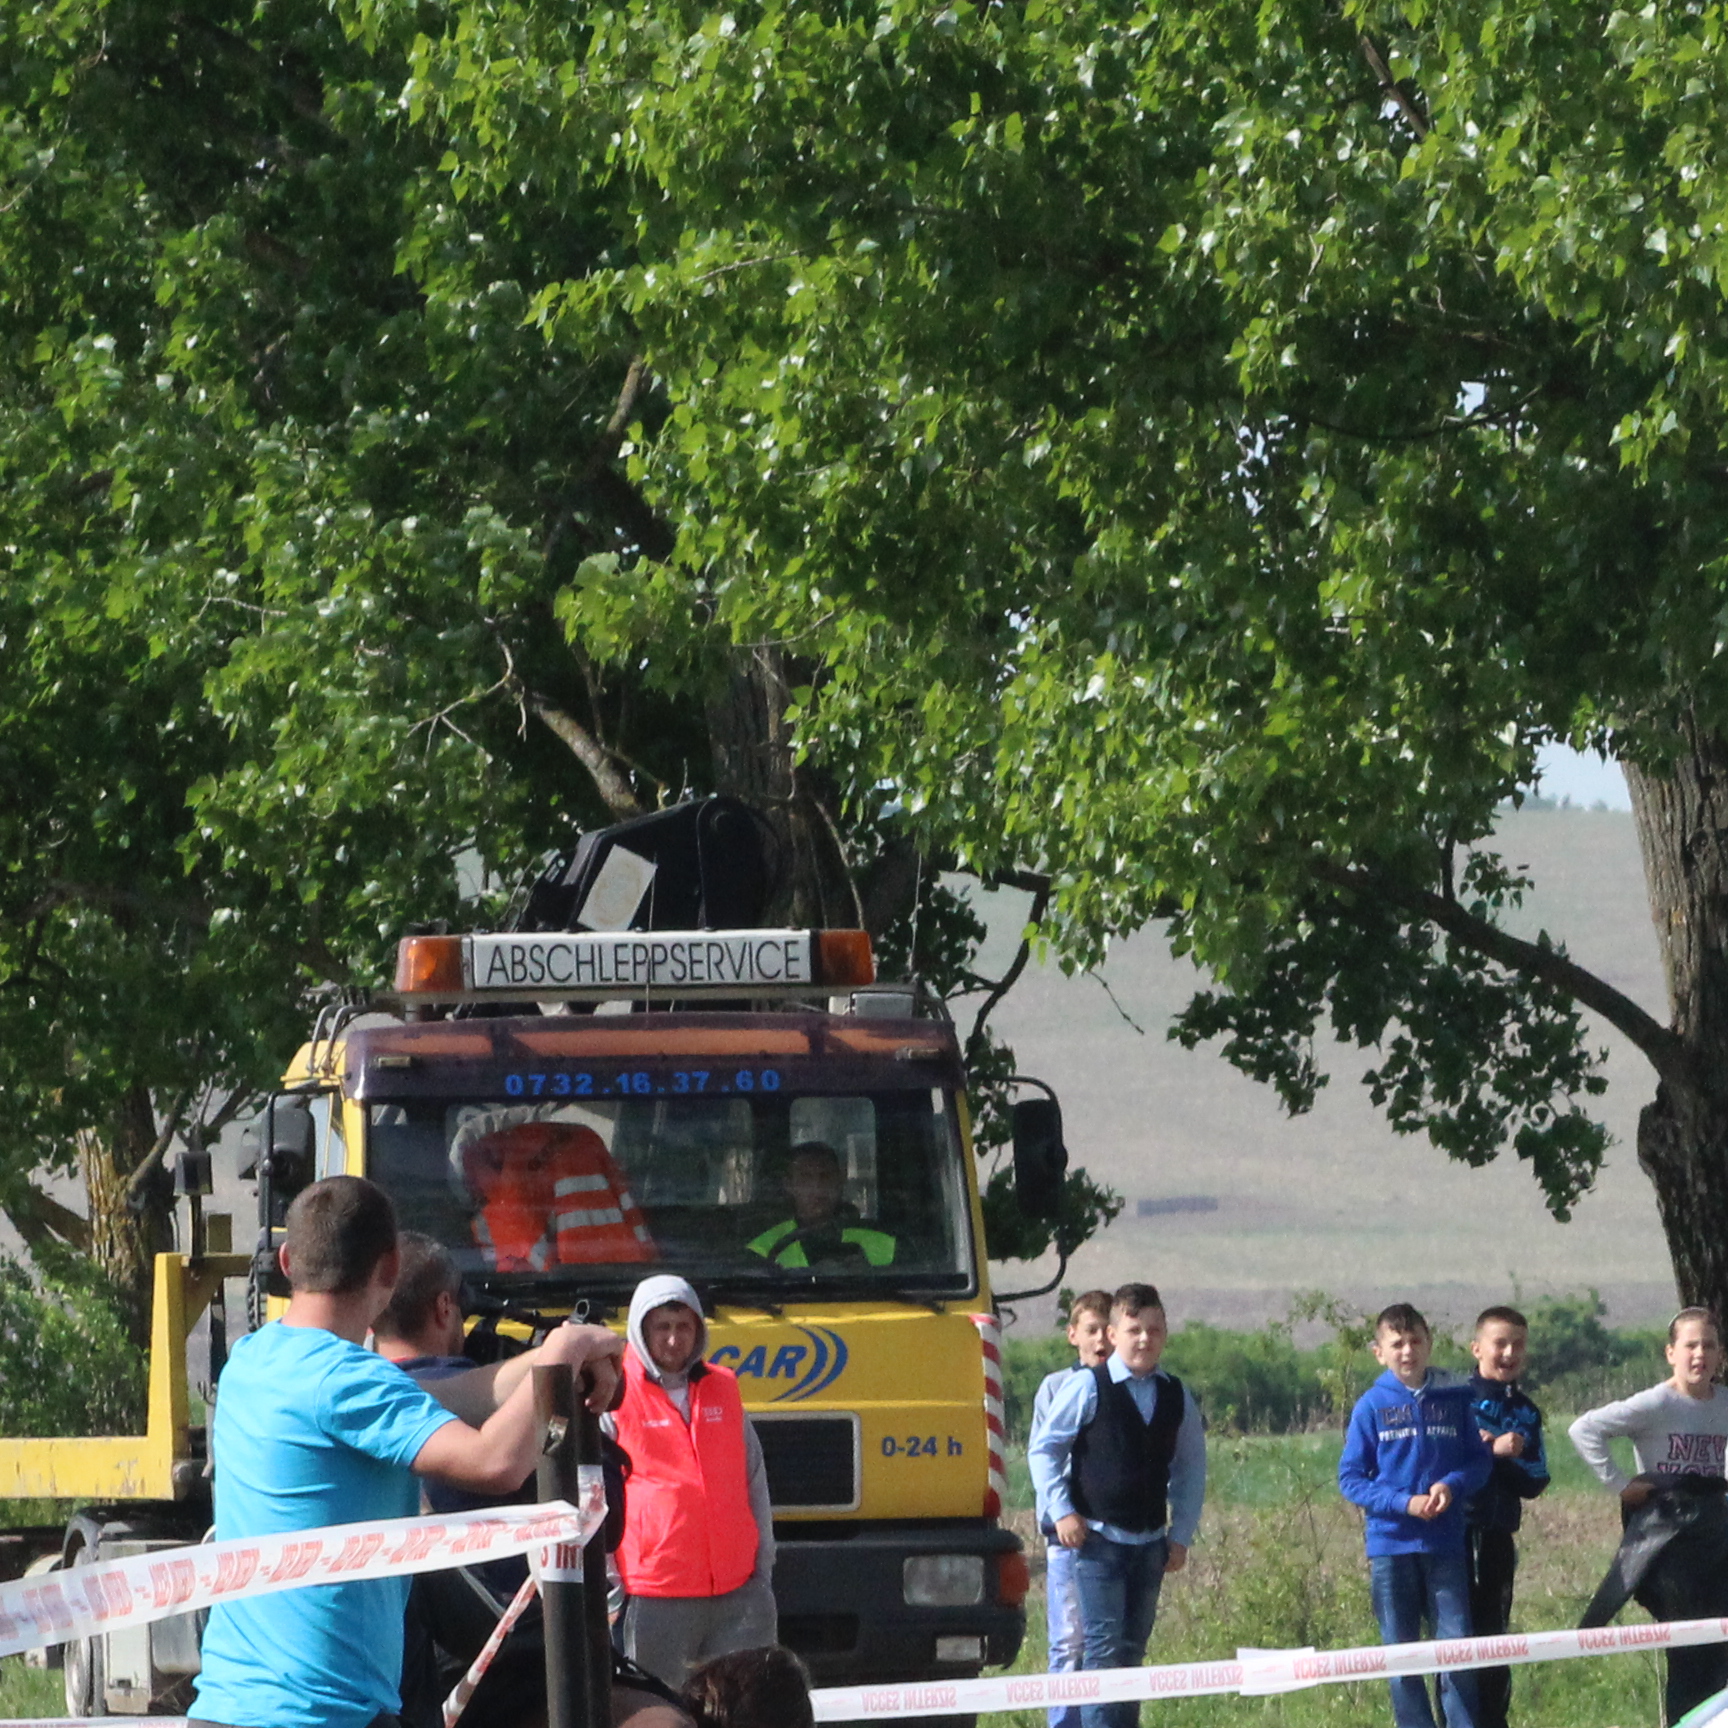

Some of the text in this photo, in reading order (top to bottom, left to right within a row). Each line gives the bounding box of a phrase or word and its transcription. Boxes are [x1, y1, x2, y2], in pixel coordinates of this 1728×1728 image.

[487, 940, 800, 983] ABSCHLEPPSERVICE
[881, 1436, 963, 1458] 0-24 h
